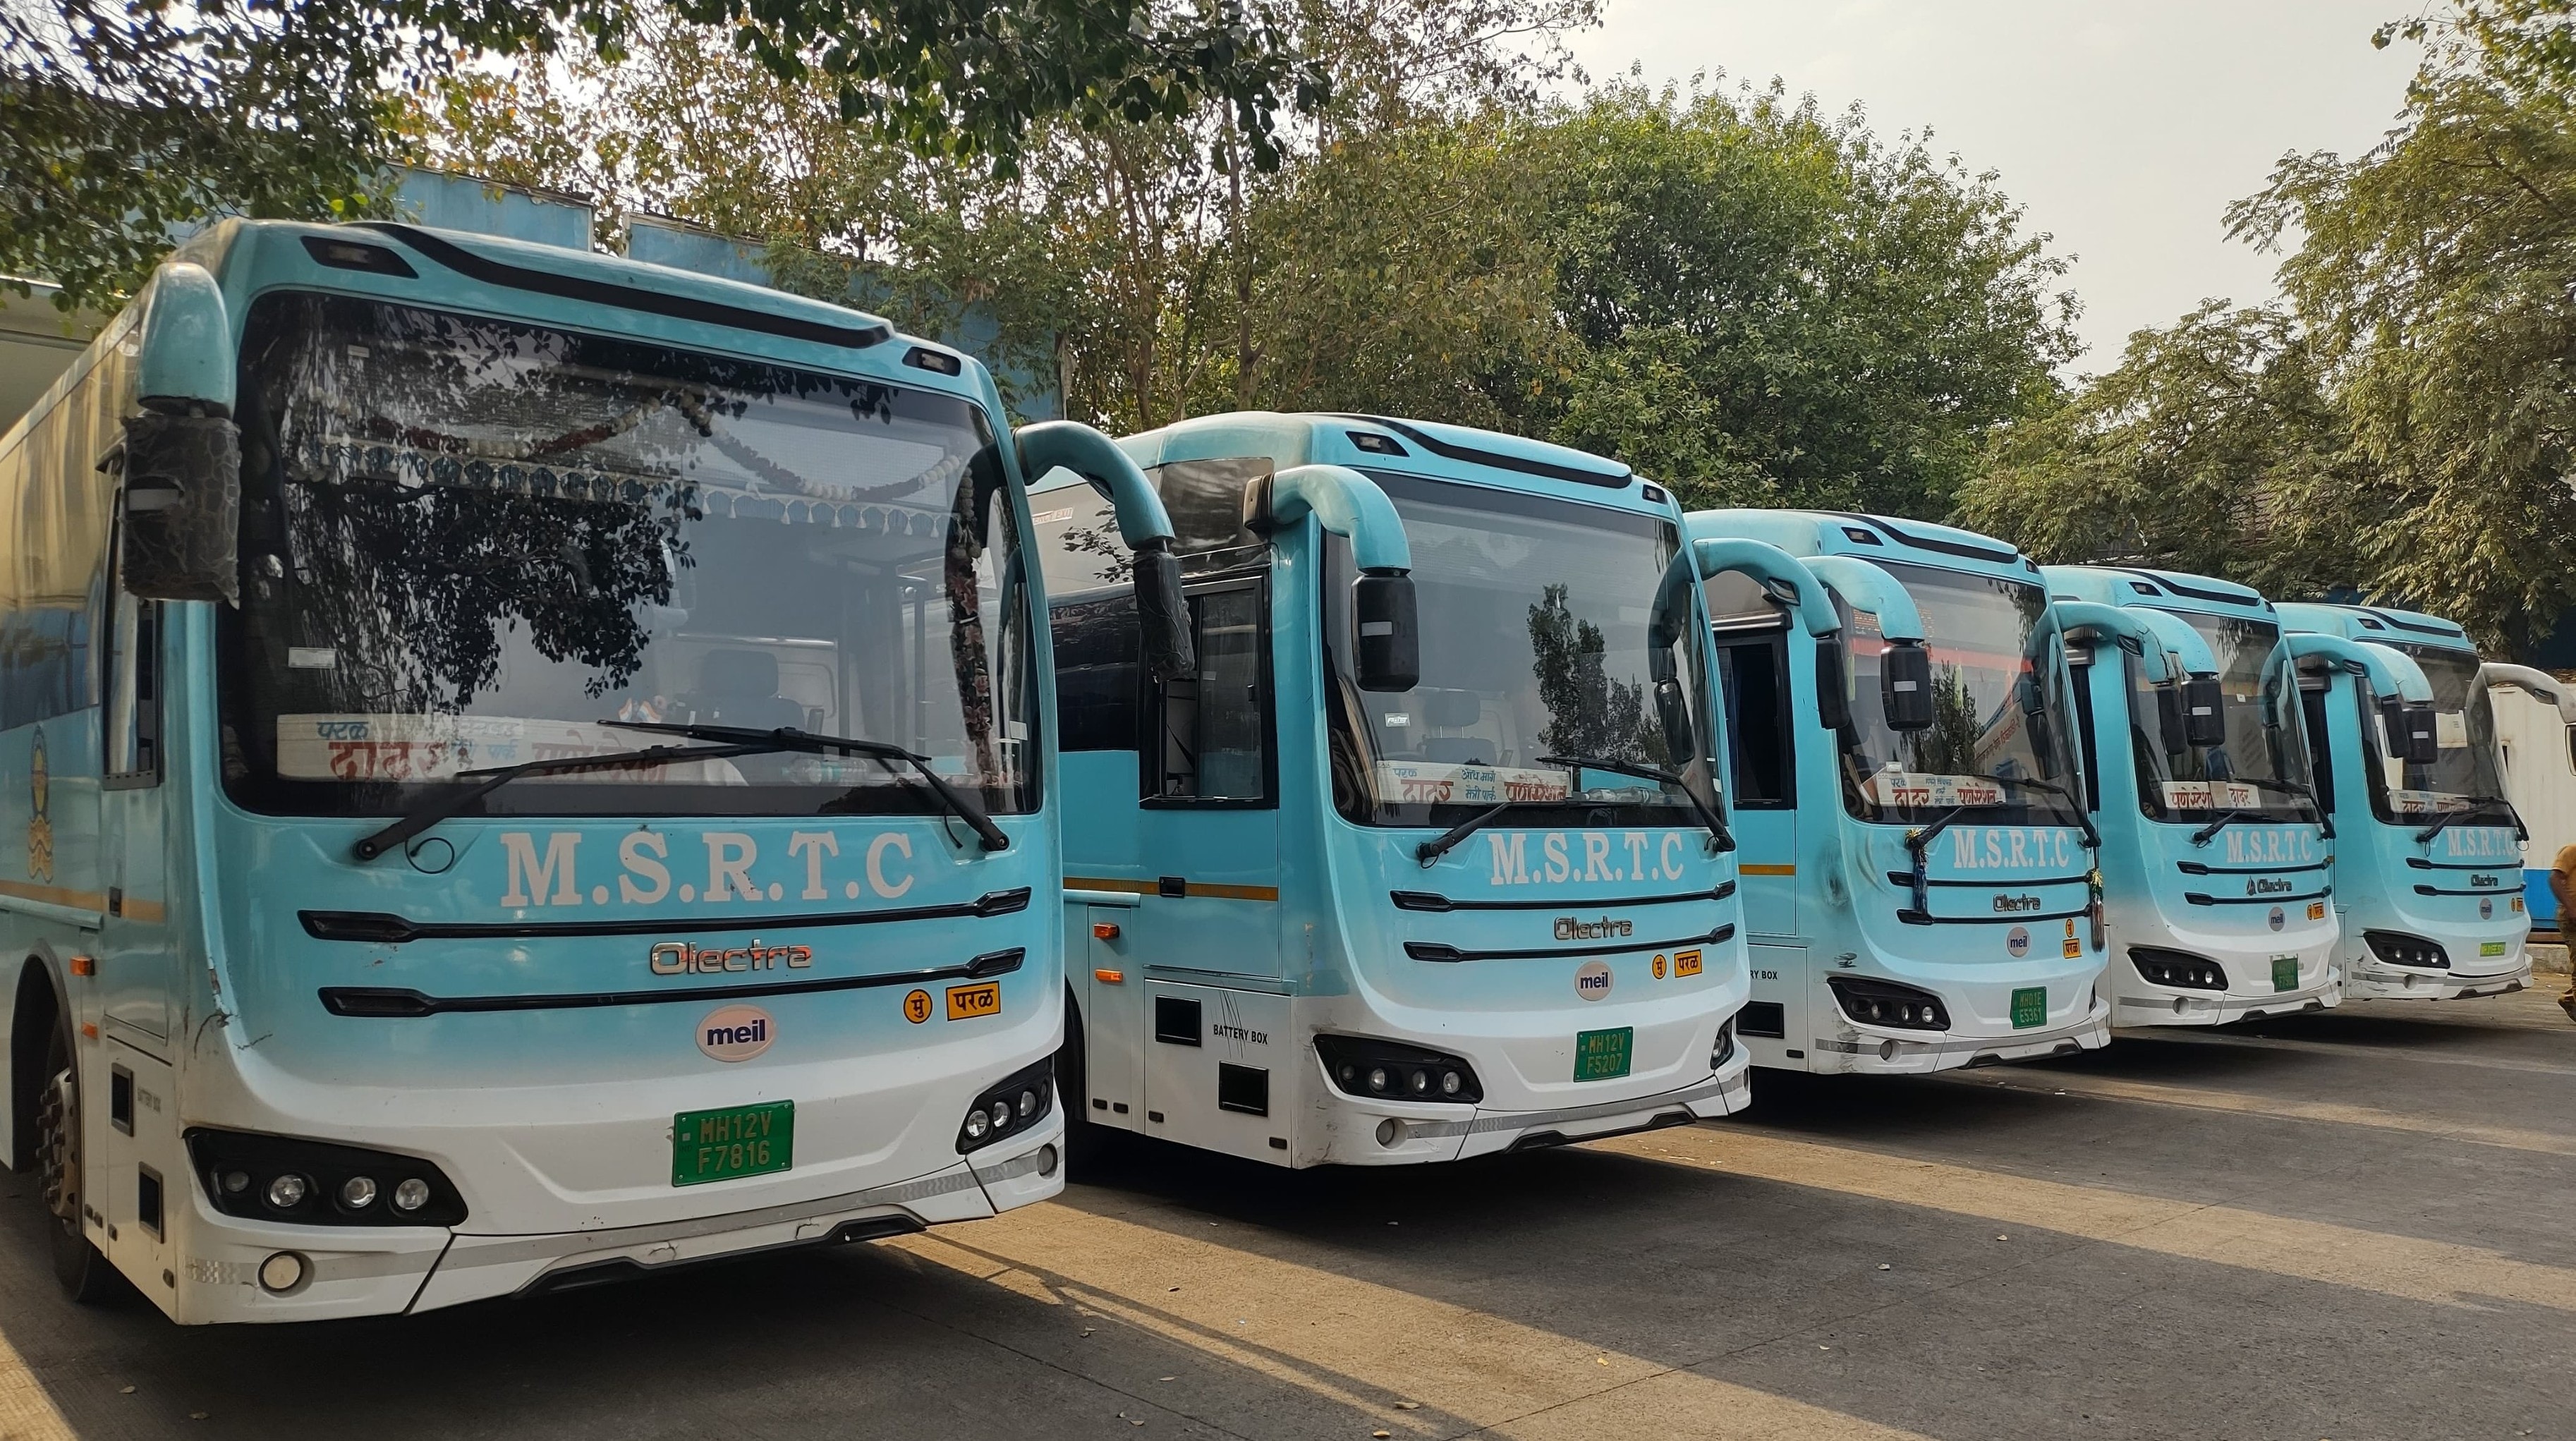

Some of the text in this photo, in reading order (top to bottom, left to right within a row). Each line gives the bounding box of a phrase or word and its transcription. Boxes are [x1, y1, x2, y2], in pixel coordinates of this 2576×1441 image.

[1488, 832, 1684, 884] M.S.R.T.C
[1952, 829, 2070, 868] M.S.R.T.C
[2226, 830, 2312, 863] M.S.R.T.C
[500, 831, 915, 908] M.S.R.T.C
[1993, 893, 2041, 913] Olectra
[1554, 916, 1633, 940] Olectra
[2010, 935, 2027, 949] meil
[650, 939, 811, 975] Olectra
[1677, 955, 1699, 971] परळ
[1579, 972, 1609, 989] meil
[1761, 971, 1778, 980] BOX
[952, 988, 994, 1011] परळ
[706, 1019, 766, 1047] meil
[1214, 1024, 1268, 1045] BATTERY BOX
[1589, 1033, 1624, 1054] MH12V
[1587, 1053, 1622, 1074] F5207
[700, 1110, 772, 1145] MH12V
[698, 1140, 770, 1174] F7816
